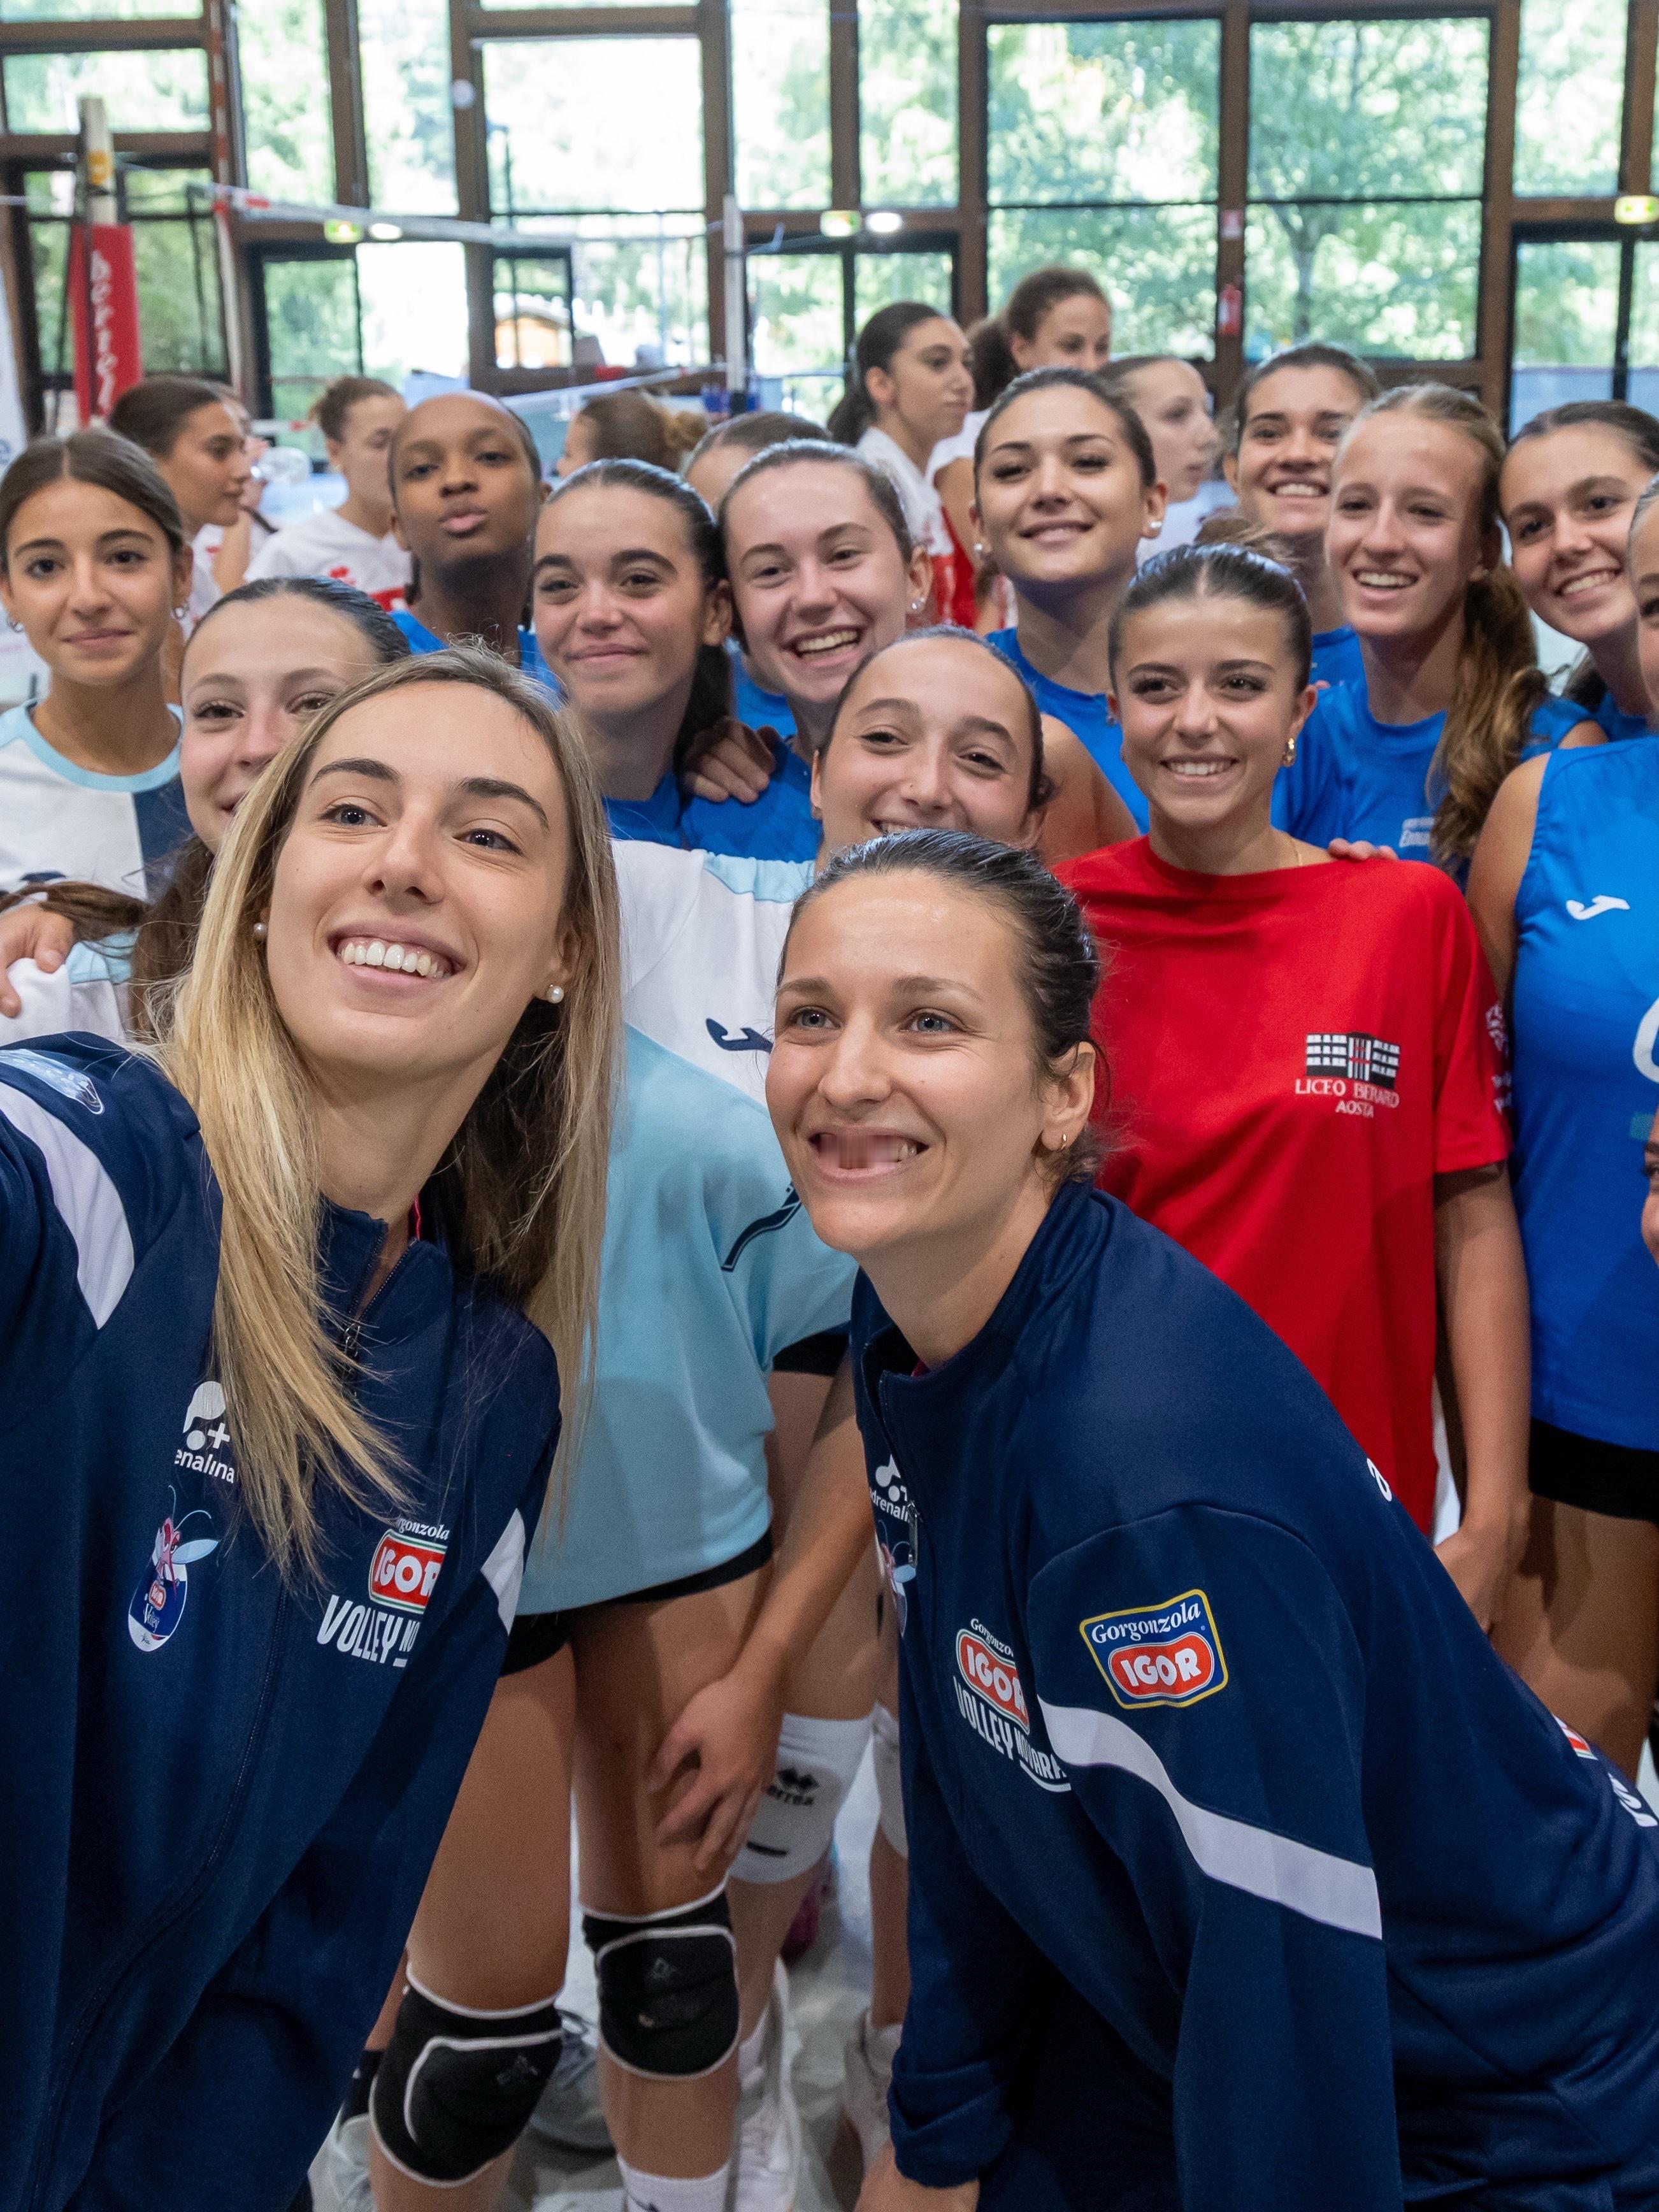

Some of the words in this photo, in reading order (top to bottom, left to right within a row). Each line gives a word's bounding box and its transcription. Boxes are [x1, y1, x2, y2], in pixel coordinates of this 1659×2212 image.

[1295, 1078, 1346, 1096] LICEO
[1335, 1100, 1374, 1118] AOSTA
[870, 1487, 910, 1523] drenali
[317, 1594, 404, 1664] VOLLEY
[970, 1618, 1014, 1657] Gorgonzo
[1091, 1602, 1201, 1644] Gorgonzola
[1120, 1648, 1202, 1687] IGOR
[953, 1675, 1014, 1761] VOLLEY
